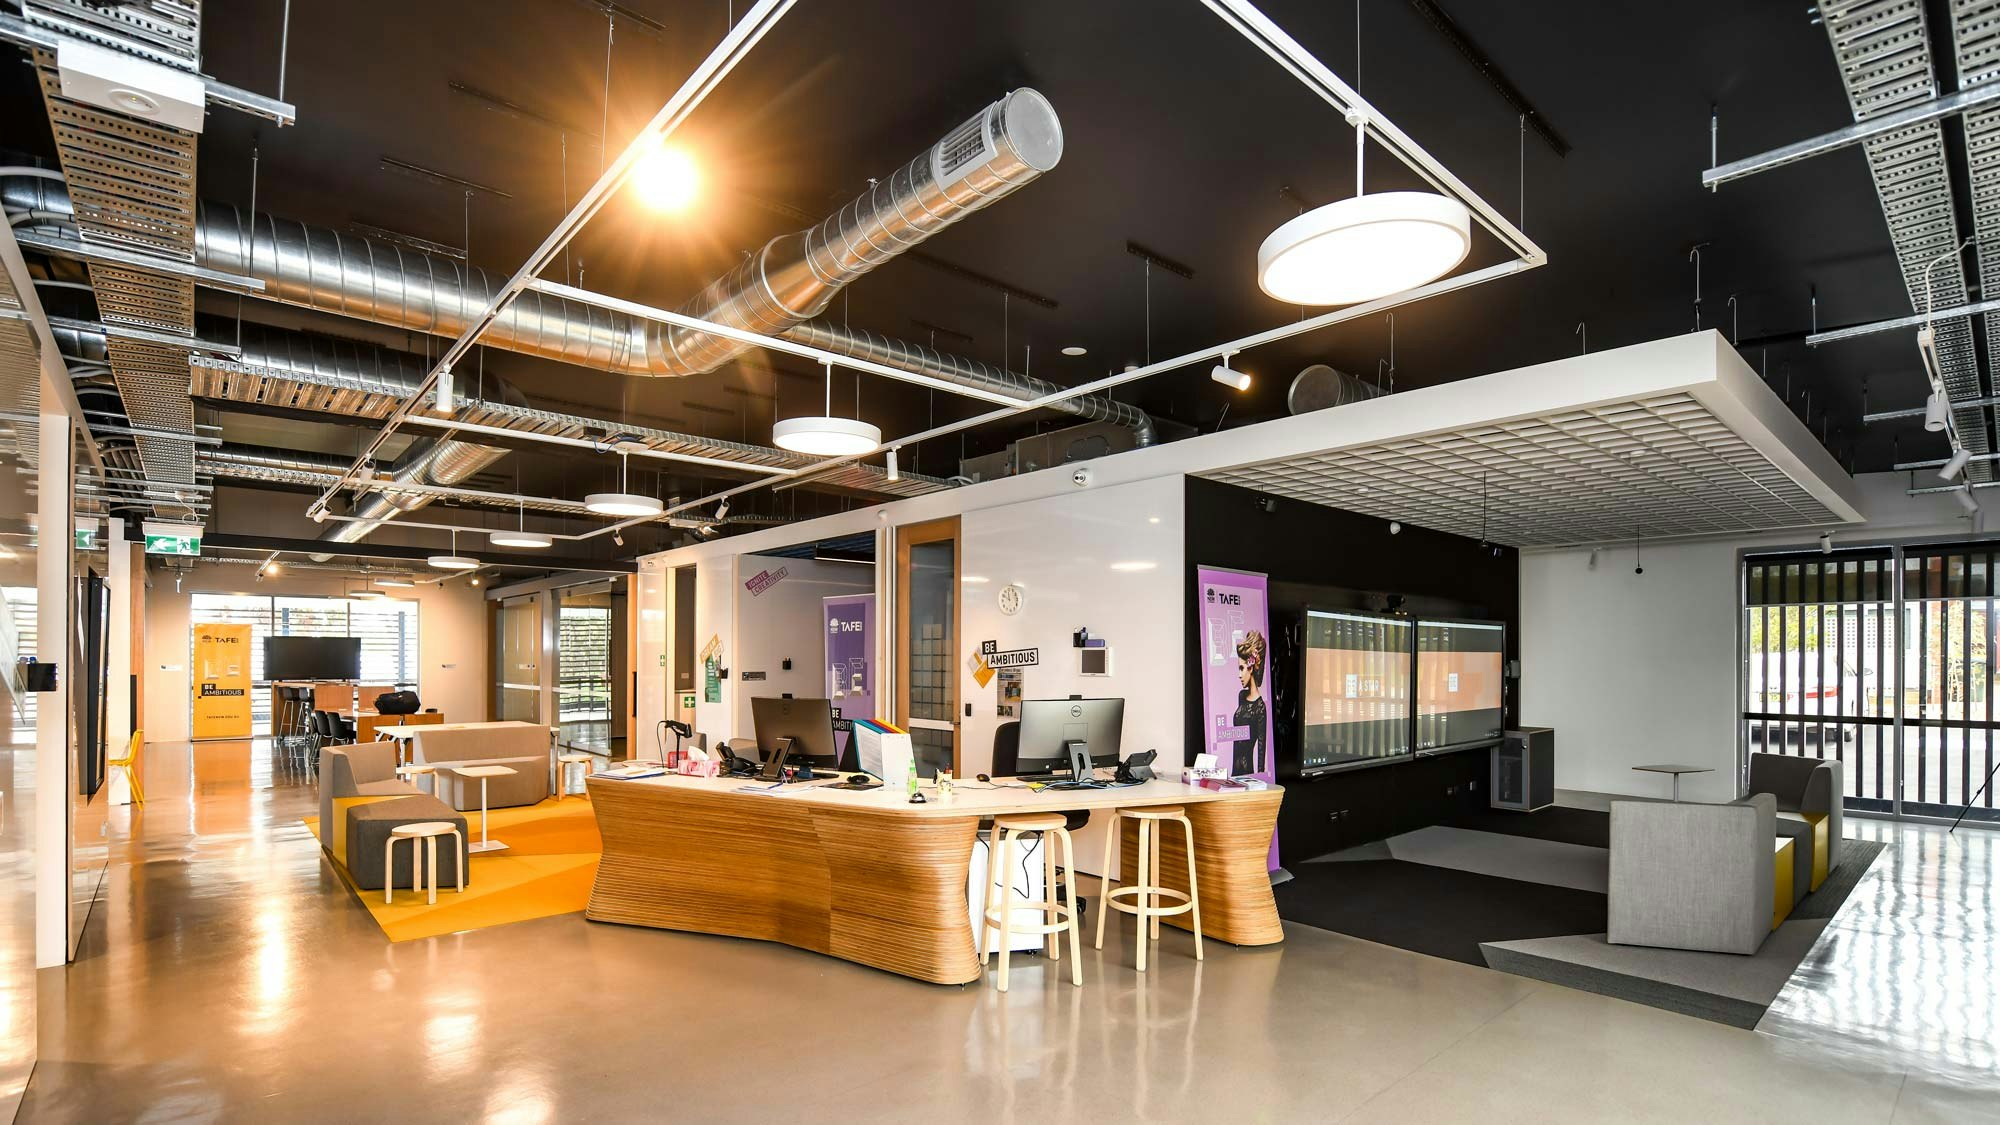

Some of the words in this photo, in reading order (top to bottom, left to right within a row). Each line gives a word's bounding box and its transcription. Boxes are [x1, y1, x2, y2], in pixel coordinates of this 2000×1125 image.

[984, 642, 995, 653] BE
[990, 651, 1036, 666] AMBITIOUS
[832, 709, 839, 718] BE
[833, 720, 853, 730] AMBITI
[1217, 717, 1225, 726] BE
